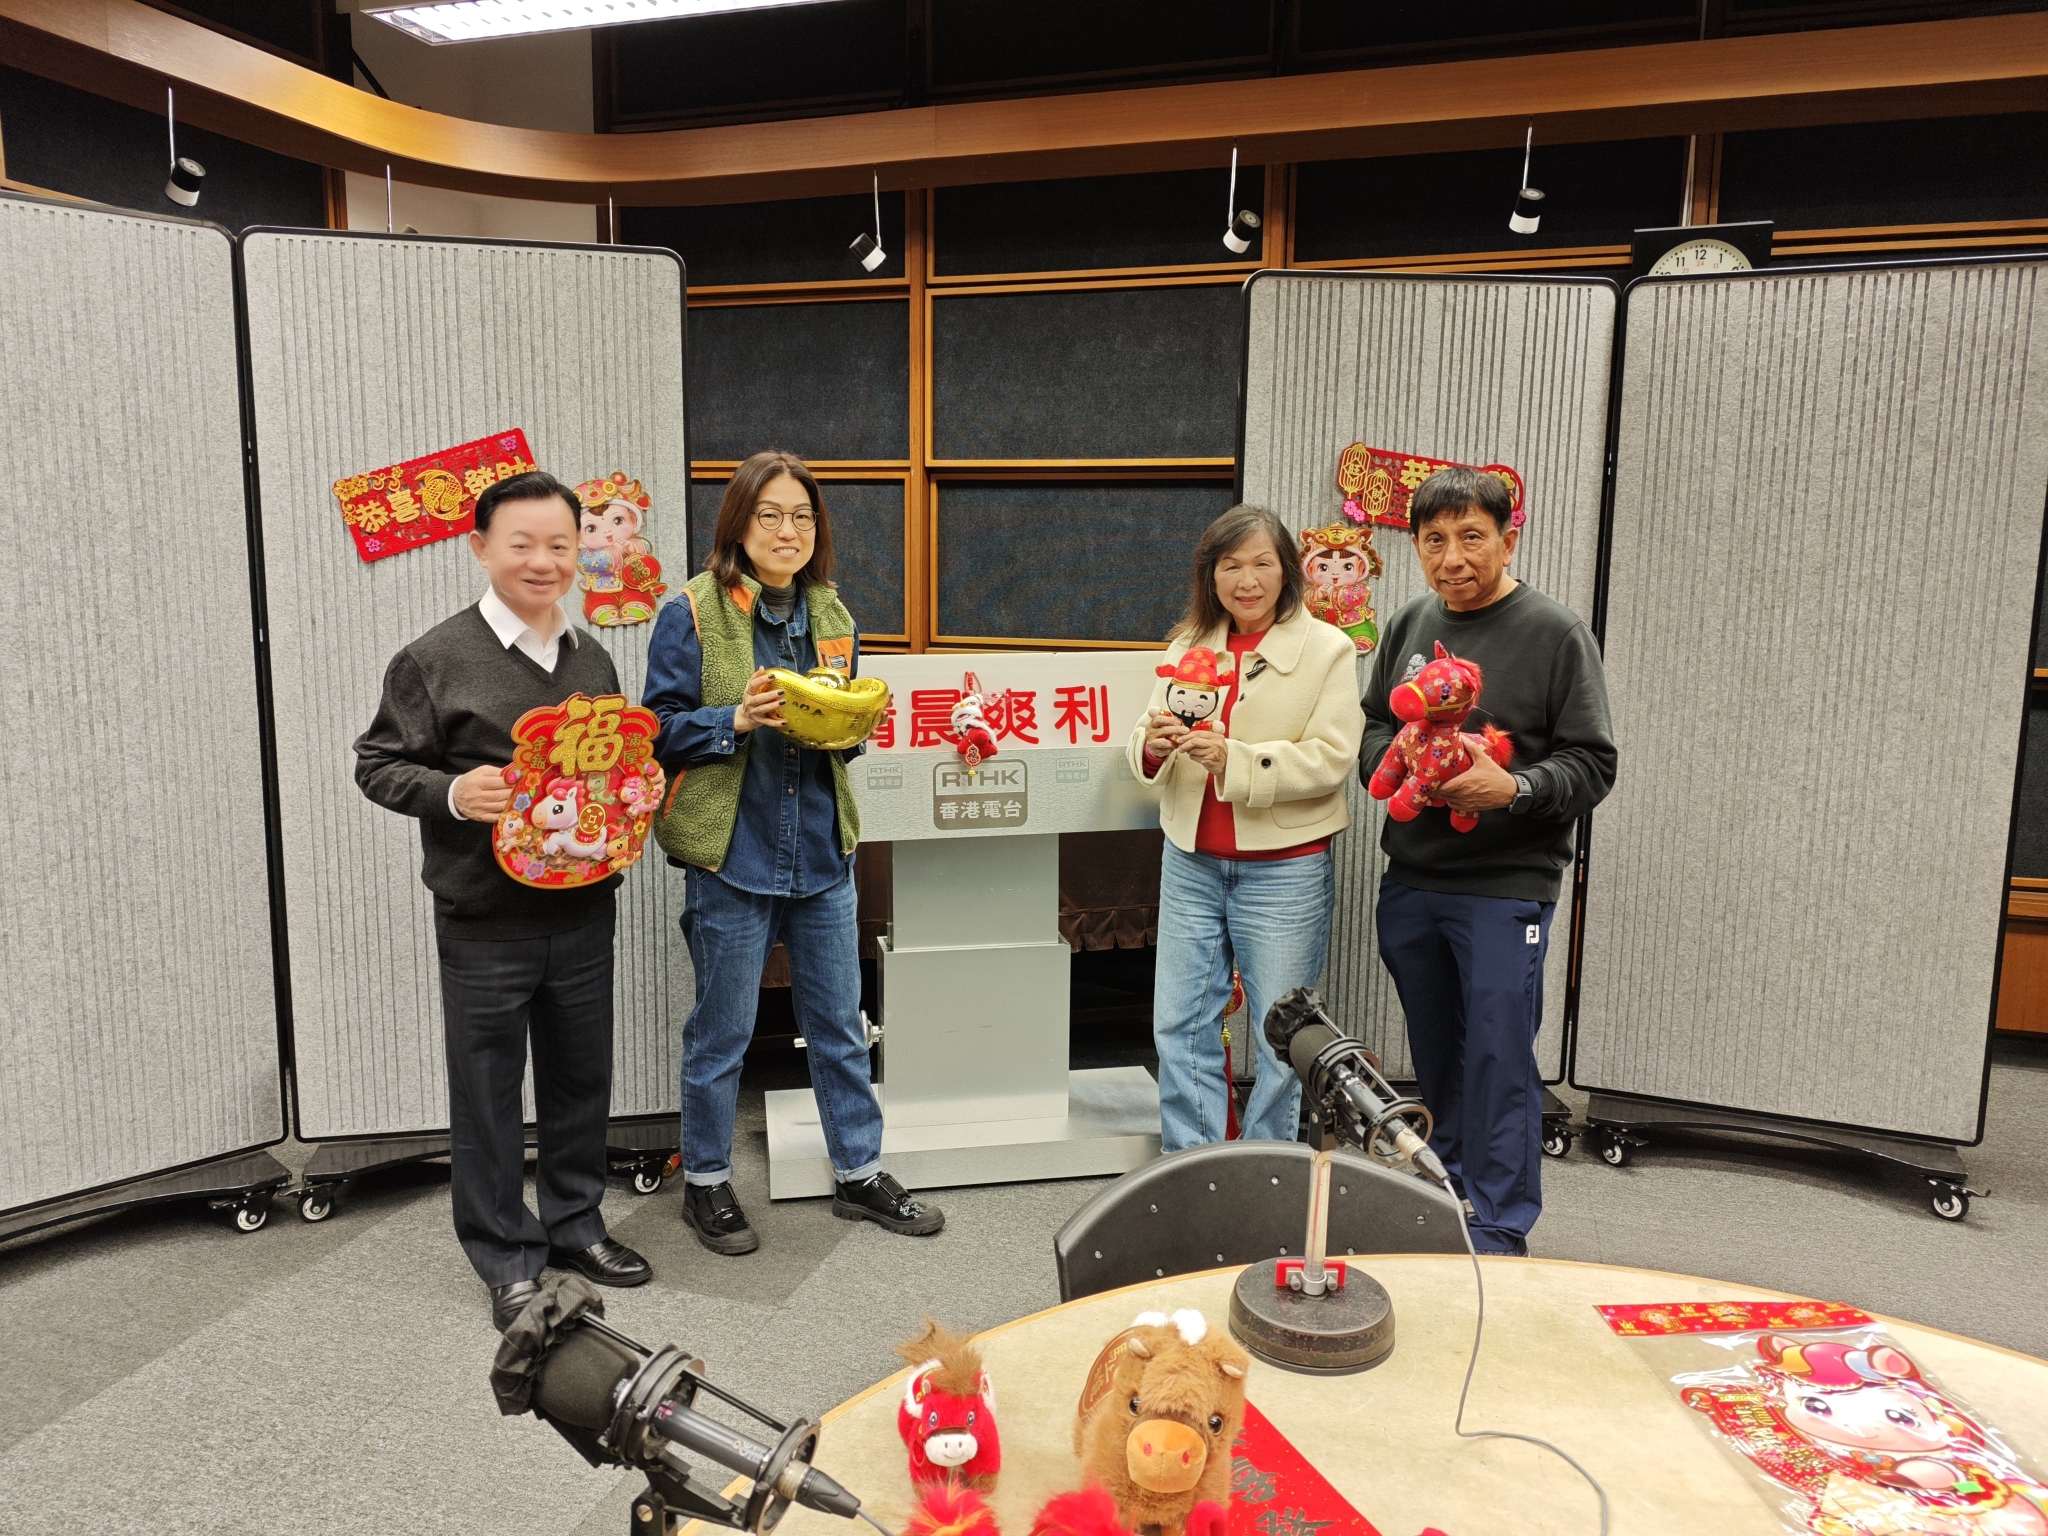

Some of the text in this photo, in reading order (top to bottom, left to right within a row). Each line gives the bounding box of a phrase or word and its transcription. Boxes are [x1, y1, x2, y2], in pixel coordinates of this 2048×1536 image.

[1675, 257, 1686, 268] 11
[1695, 249, 1707, 261] 12
[1719, 253, 1723, 264] 1
[355, 489, 421, 533] 恭喜
[549, 695, 625, 777] 福
[942, 769, 1020, 788] RTHK
[939, 801, 1022, 820] 香港電台
